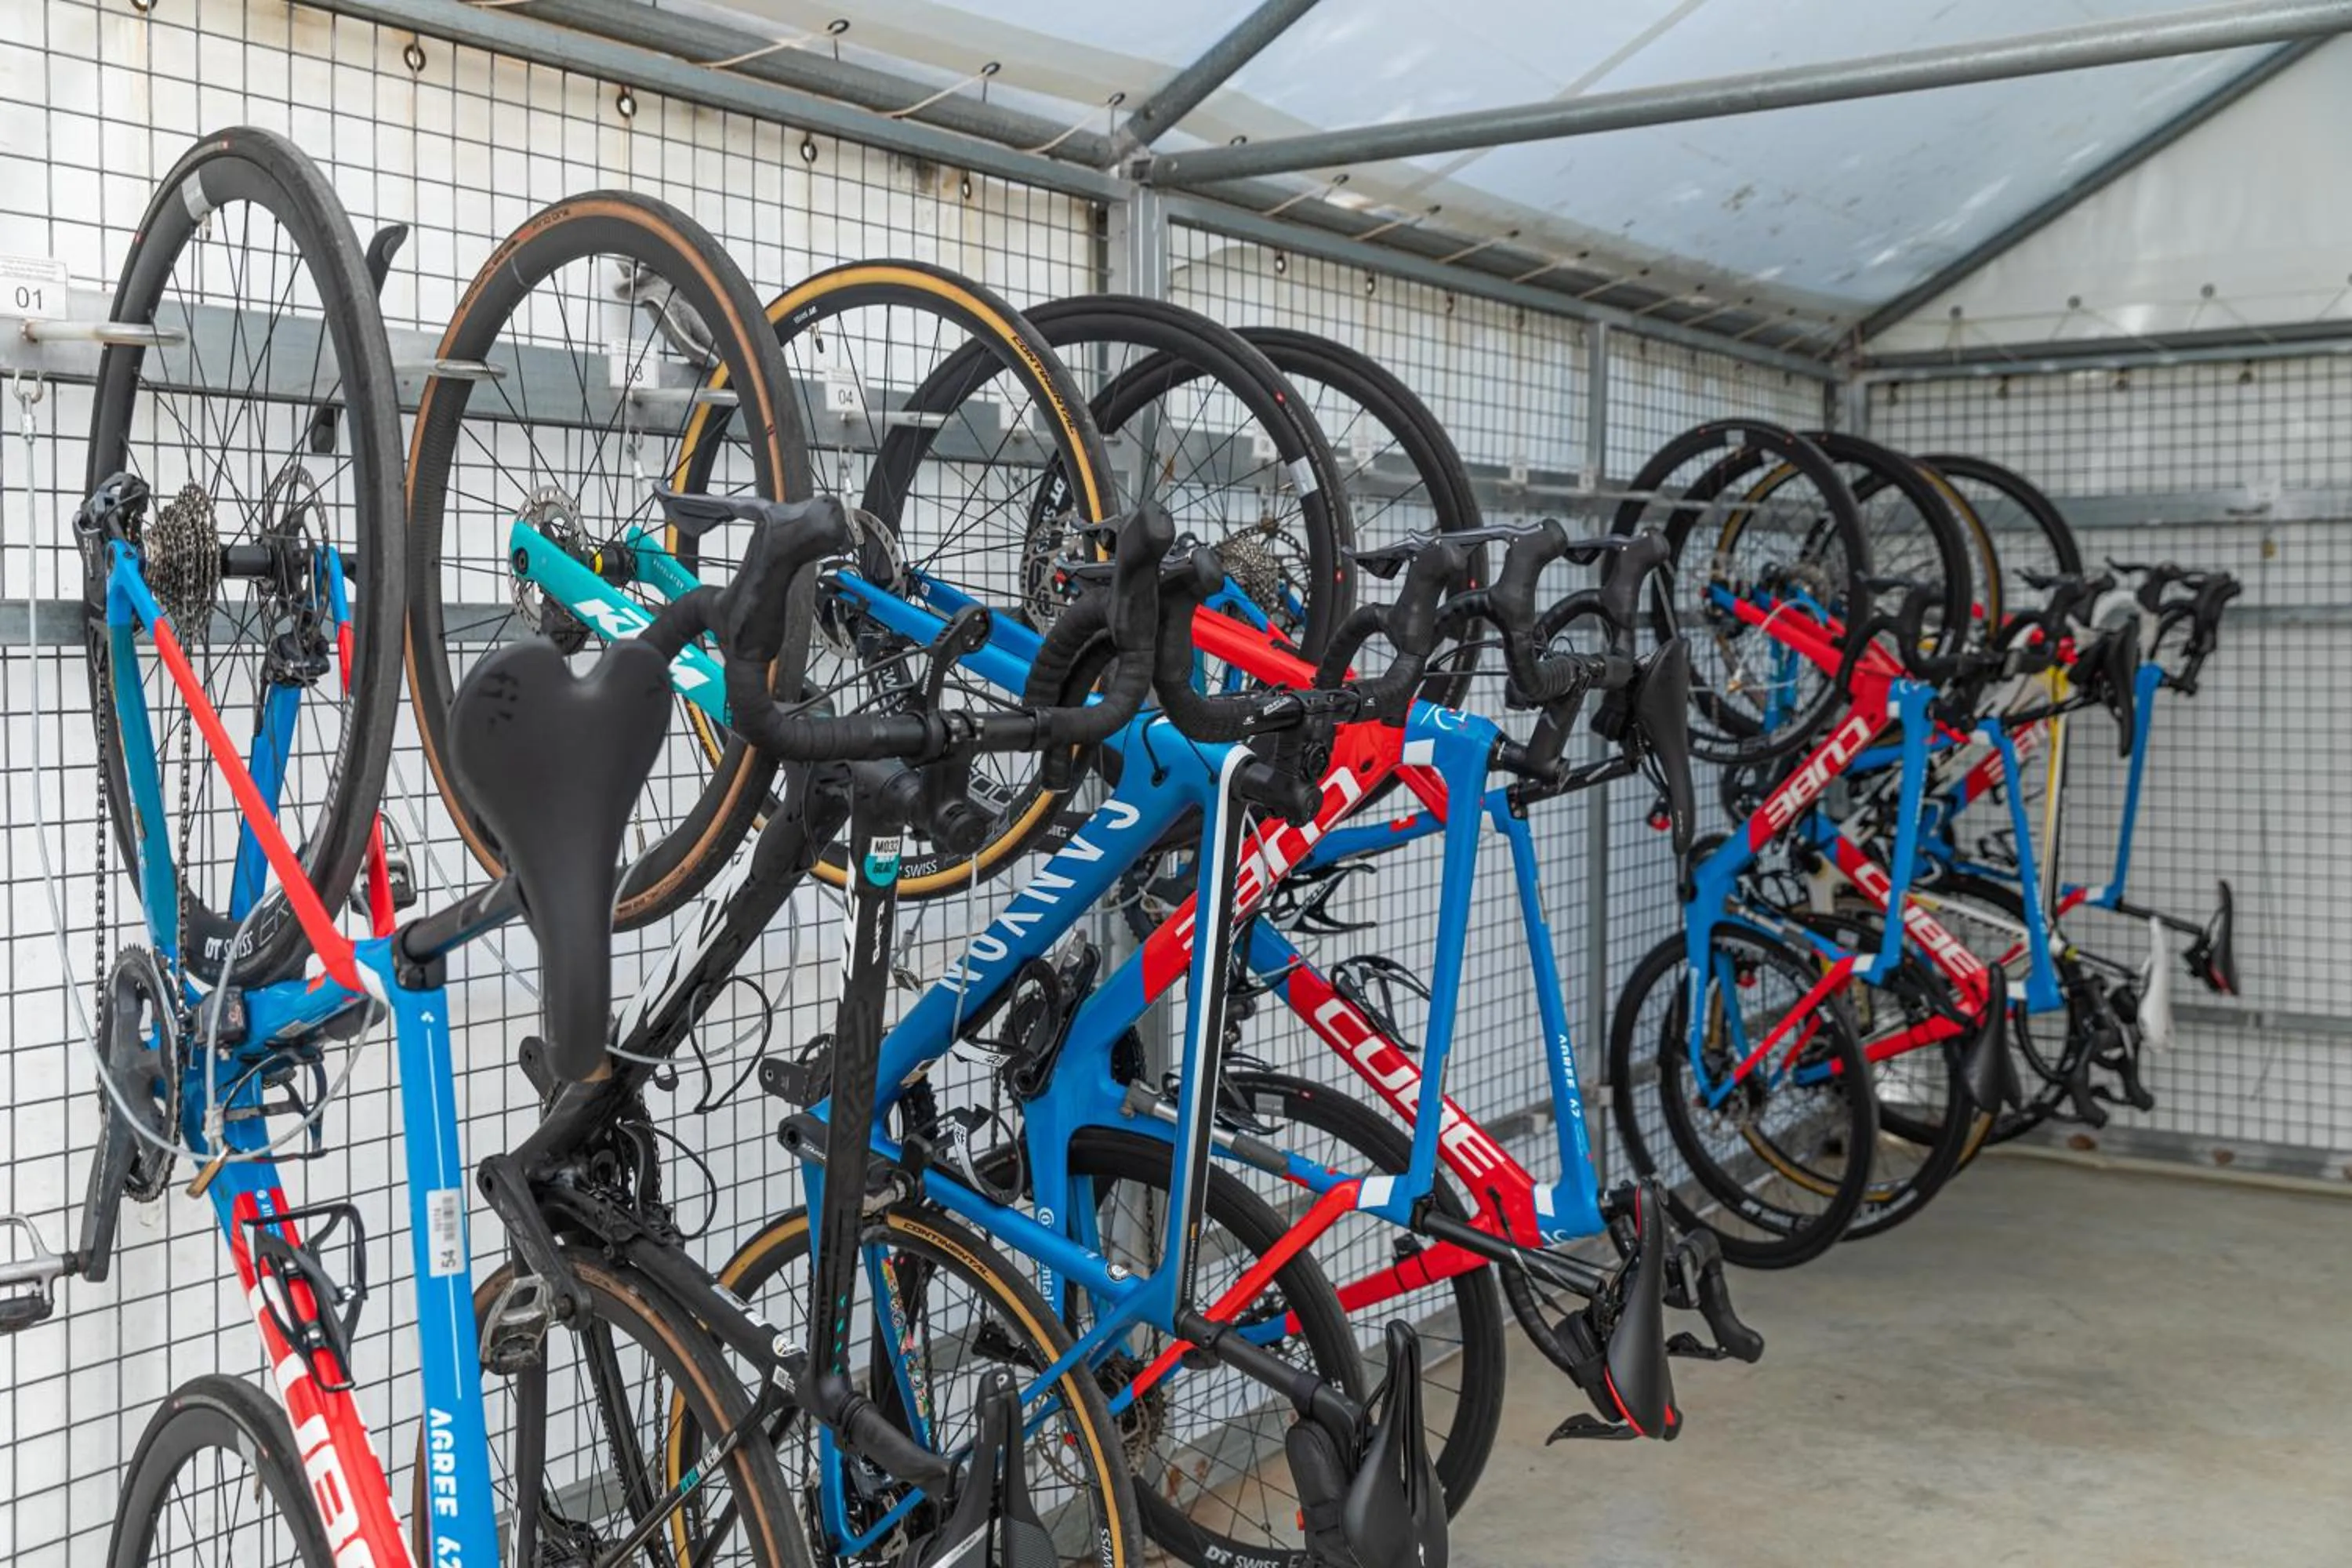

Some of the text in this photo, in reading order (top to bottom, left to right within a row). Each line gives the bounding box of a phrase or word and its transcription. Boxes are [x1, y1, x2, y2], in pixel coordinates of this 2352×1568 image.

[16, 286, 42, 310] 01
[838, 389, 854, 405] 04
[1050, 476, 1066, 506] DT
[1764, 716, 1871, 832] CUBE
[904, 860, 938, 879] SWISS
[936, 799, 1141, 995] CANYON
[204, 936, 224, 961] DT
[223, 931, 253, 960] SISS
[441, 1249, 456, 1268] 54
[903, 1221, 989, 1279] CONTINENTAL
[430, 1408, 458, 1518] AGREE
[1205, 1545, 1233, 1565] DT
